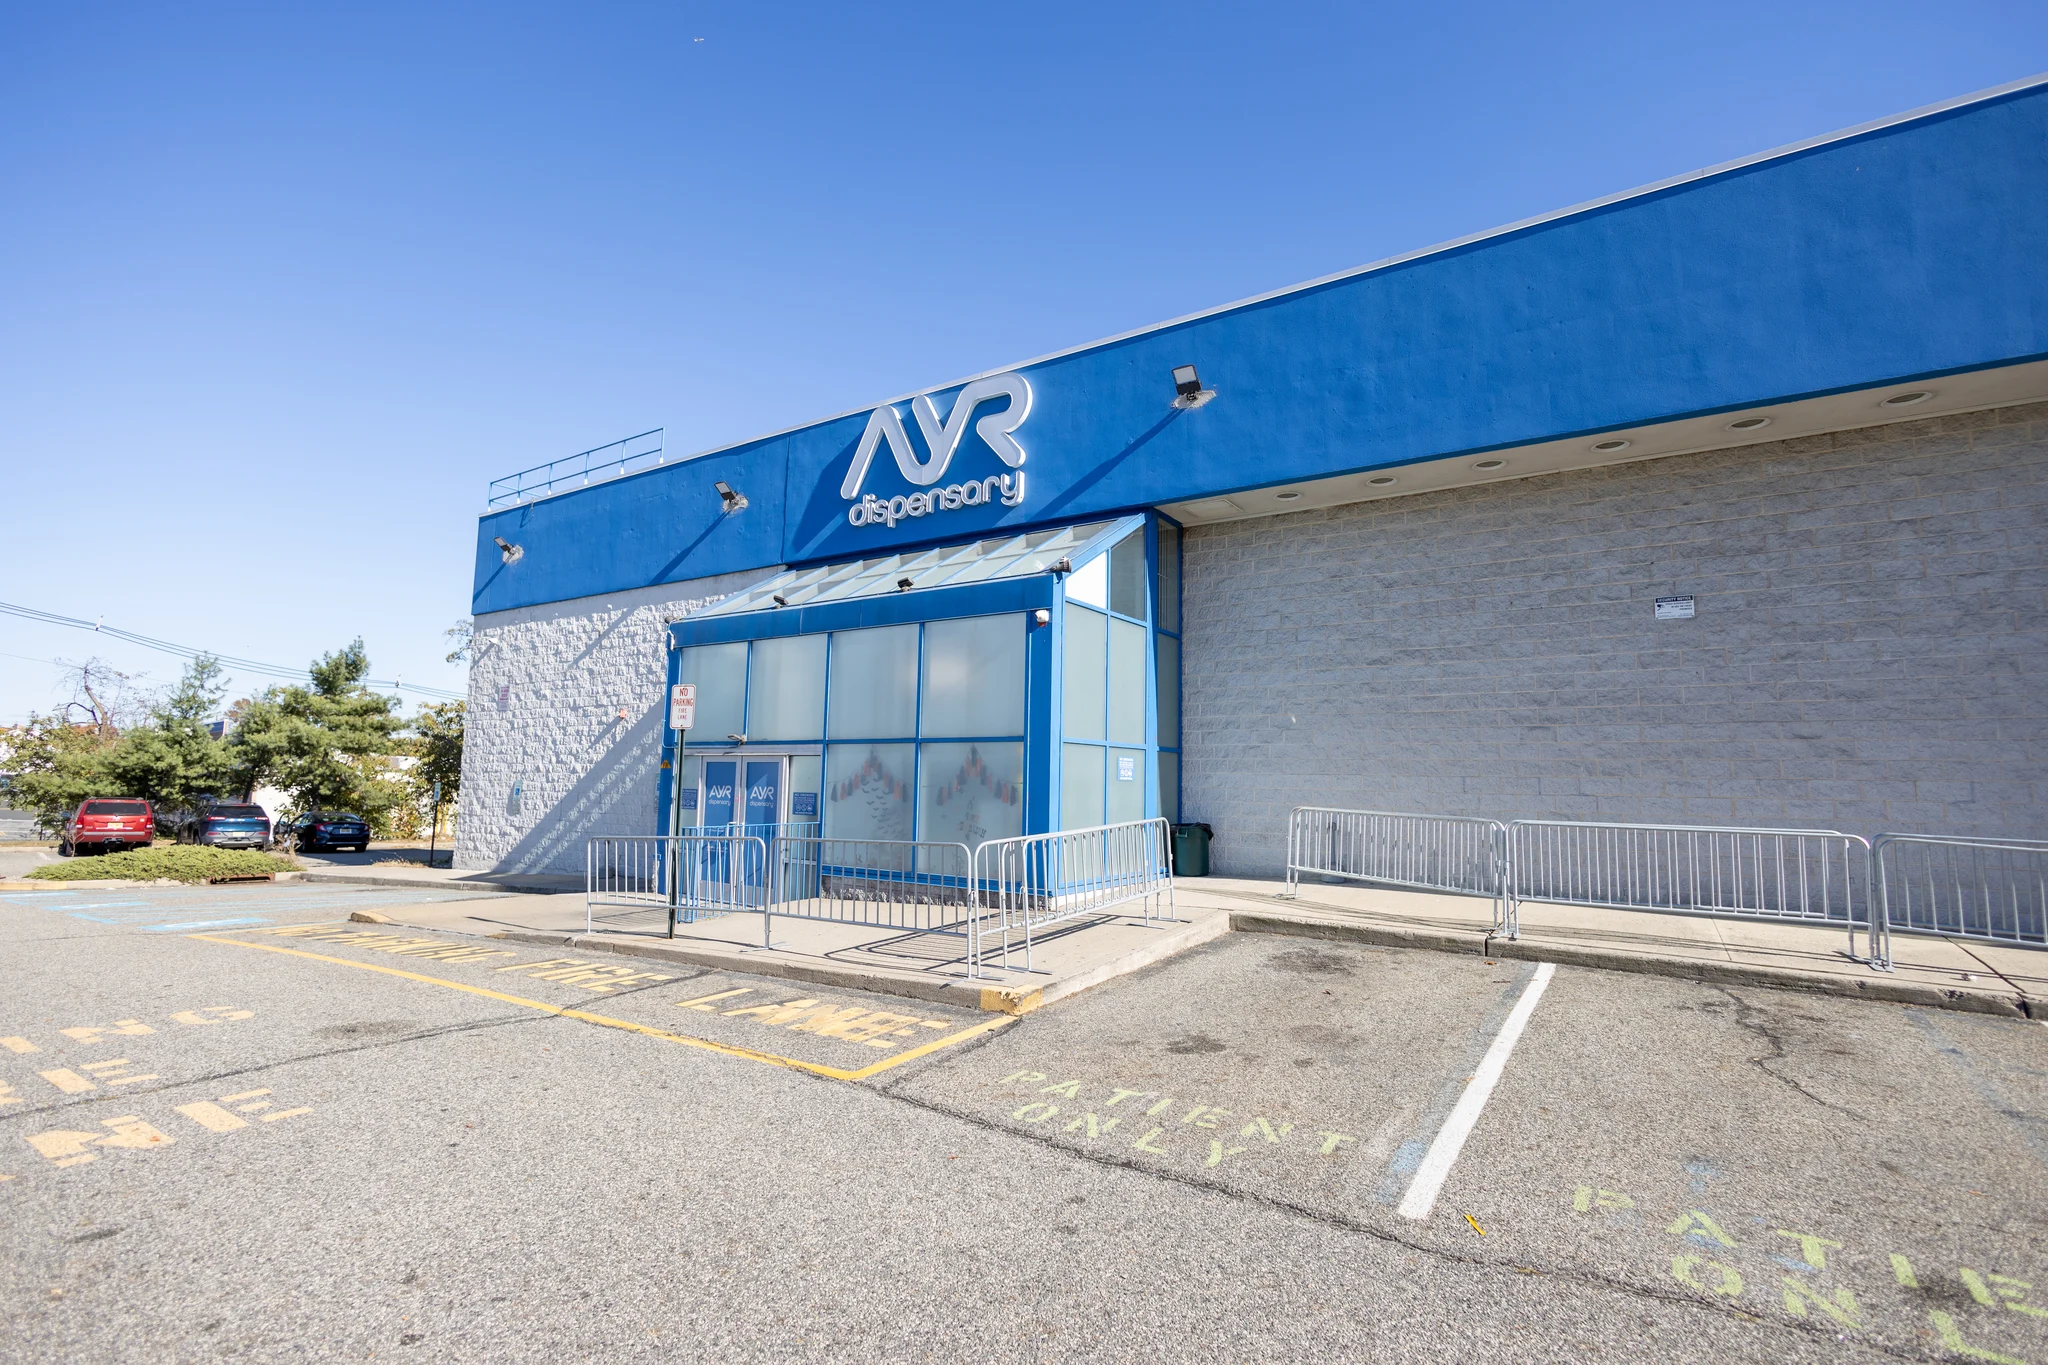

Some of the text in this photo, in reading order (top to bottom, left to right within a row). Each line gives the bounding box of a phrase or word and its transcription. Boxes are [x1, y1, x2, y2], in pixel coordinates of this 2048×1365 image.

[840, 372, 1033, 500] AYR
[849, 470, 1025, 528] dispensary
[673, 698, 694, 706] PARKING
[679, 688, 689, 697] NO
[709, 785, 732, 798] AYR
[750, 786, 774, 800] AYR
[303, 932, 517, 963] PARKING
[495, 958, 674, 992] FIRE
[675, 988, 951, 1048] LANE
[1000, 1069, 1358, 1155] PATIENT
[1012, 1102, 1248, 1167] ONLY
